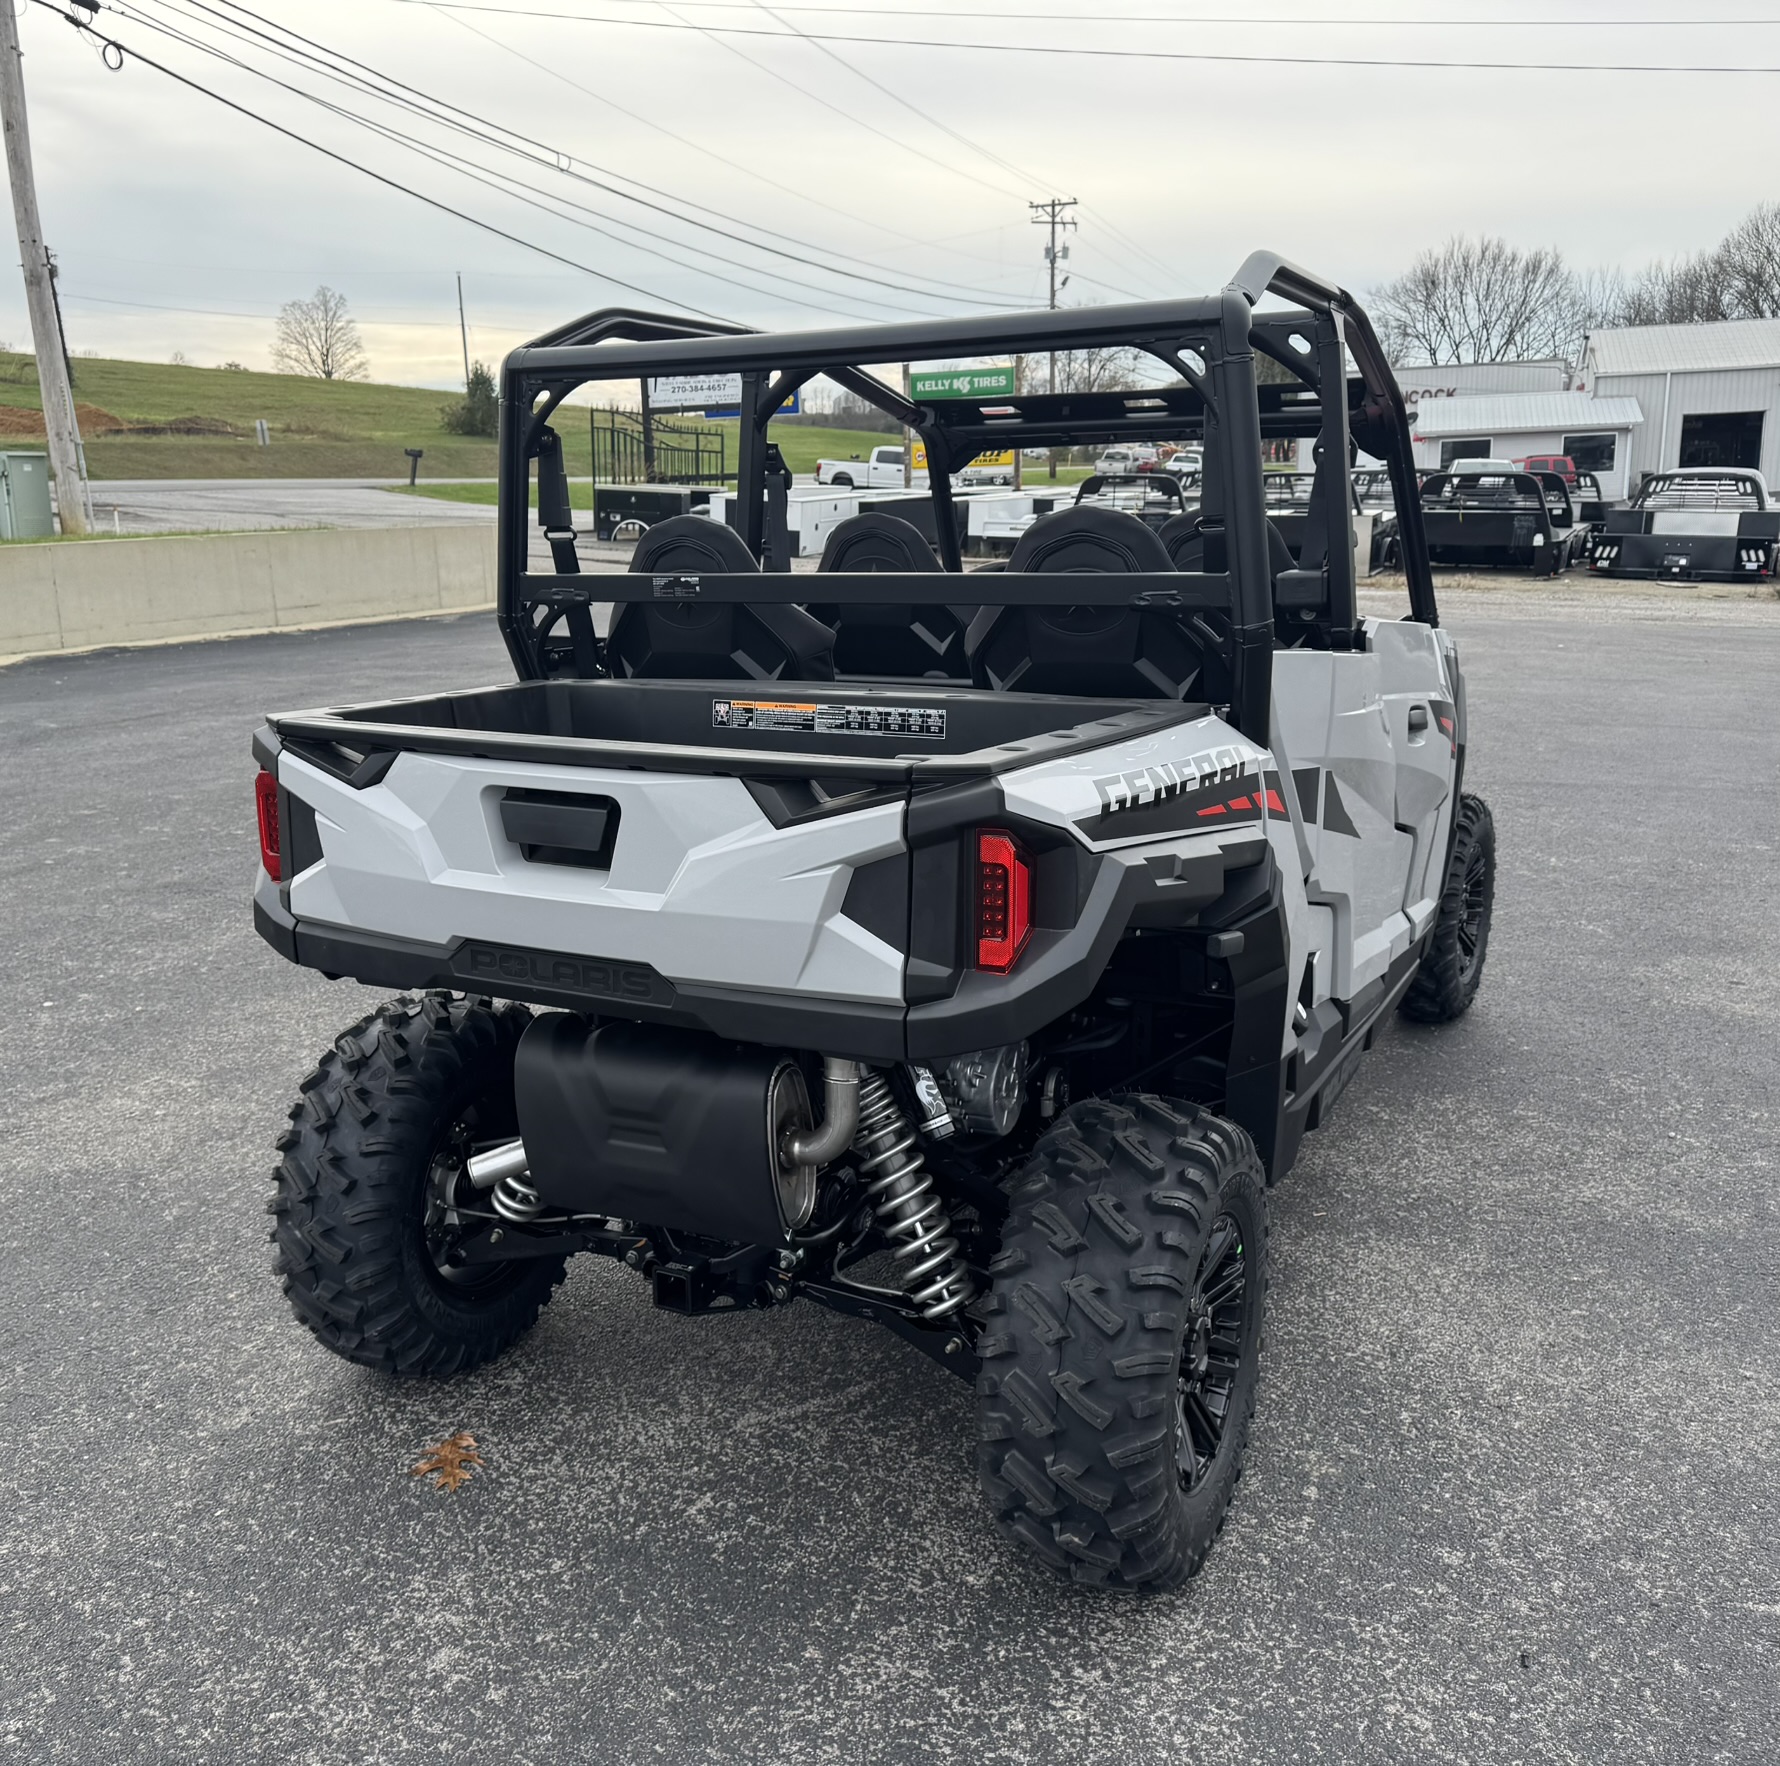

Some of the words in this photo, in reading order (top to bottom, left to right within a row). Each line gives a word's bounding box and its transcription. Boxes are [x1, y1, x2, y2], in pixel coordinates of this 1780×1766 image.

[671, 383, 727, 393] 270-384-4657
[916, 379, 950, 391] KELLY
[973, 375, 1007, 388] TIRES
[1092, 746, 1247, 817] GENERAL
[469, 948, 654, 998] POLARIS
